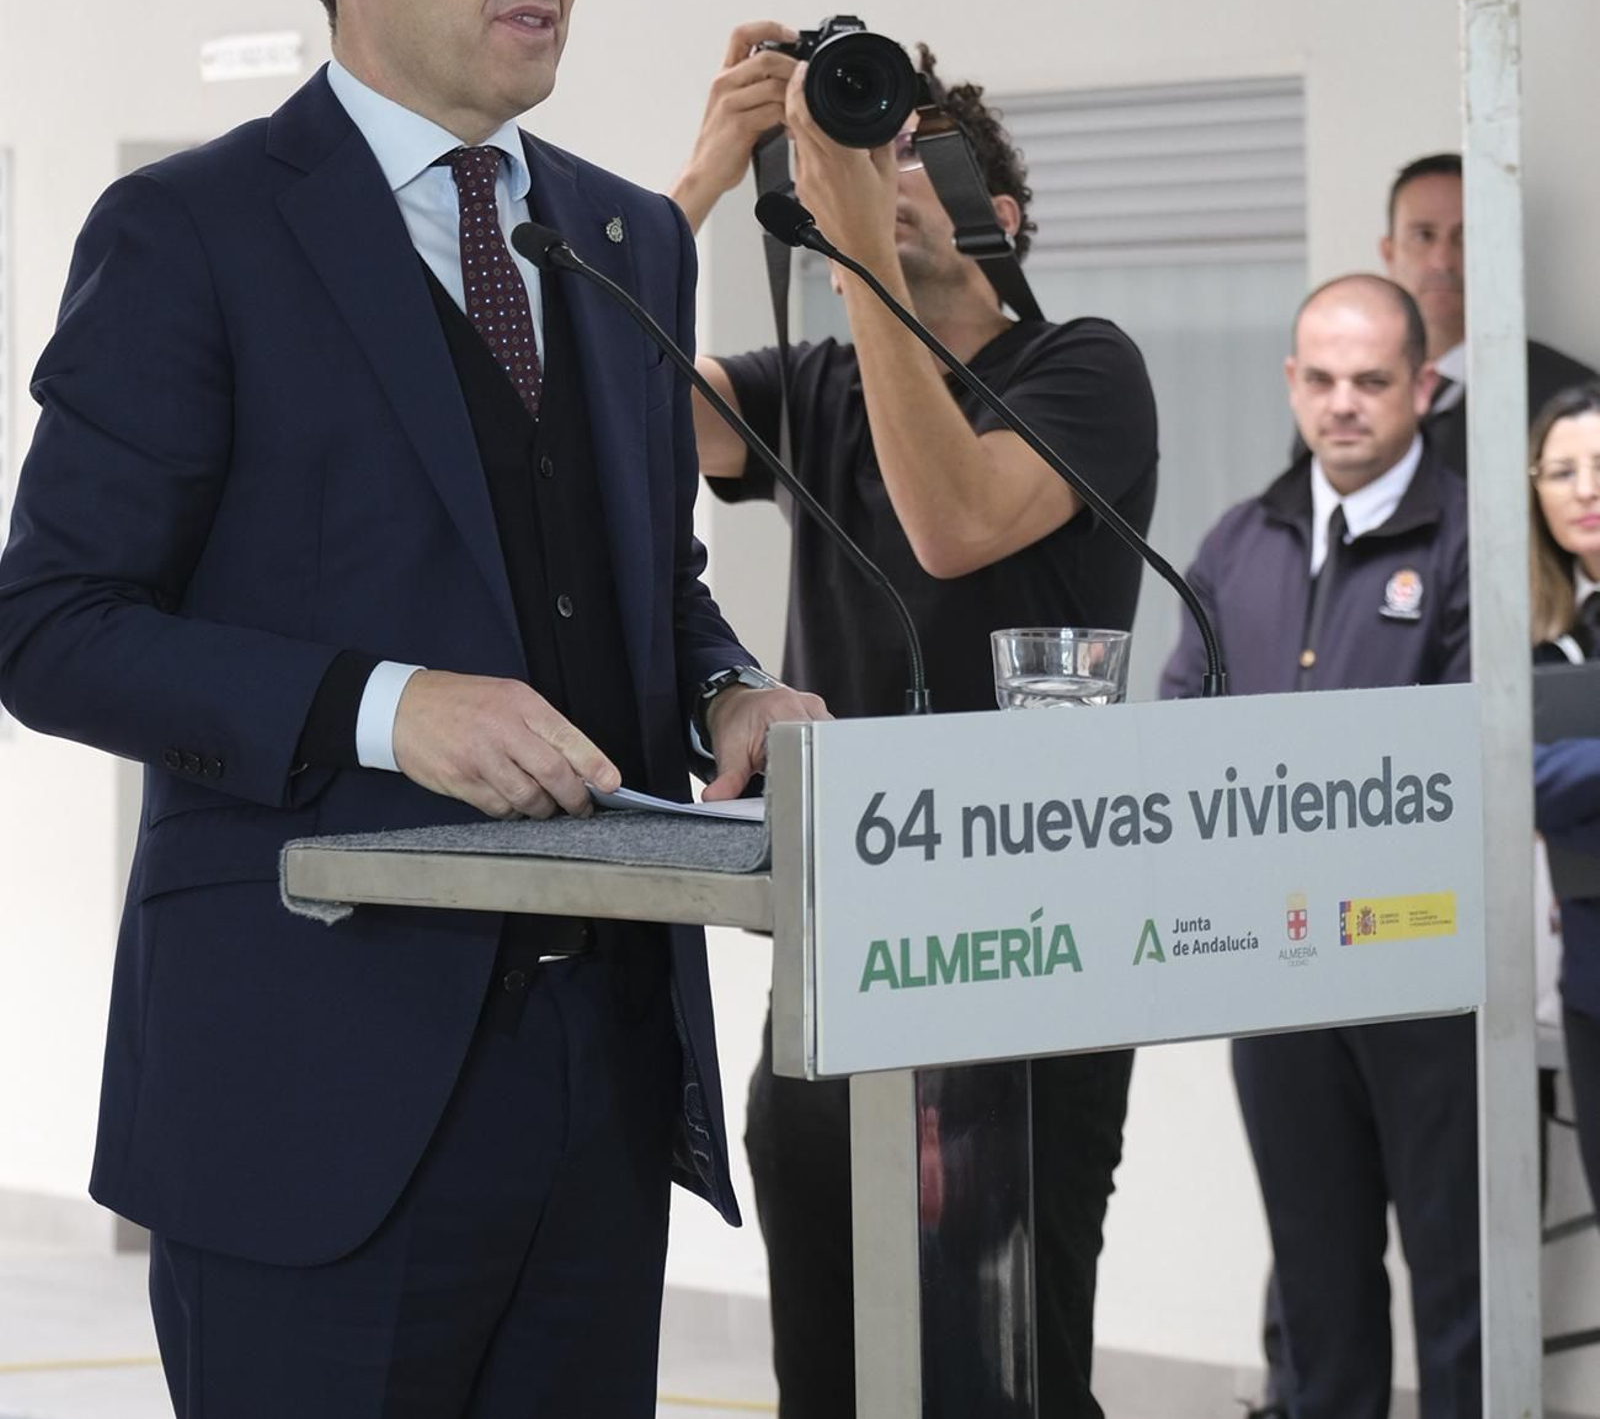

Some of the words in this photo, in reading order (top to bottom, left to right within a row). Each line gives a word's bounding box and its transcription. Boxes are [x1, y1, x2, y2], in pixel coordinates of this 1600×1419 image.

[855, 788, 942, 866] 64
[961, 792, 1173, 859] nuevas
[1188, 755, 1454, 841] viviendas
[1172, 917, 1211, 934] Junta
[859, 906, 1083, 993] ALMERÍA
[1172, 939, 1189, 956] de
[1192, 931, 1259, 955] Andalucía
[1278, 945, 1318, 961] ALMERÍA
